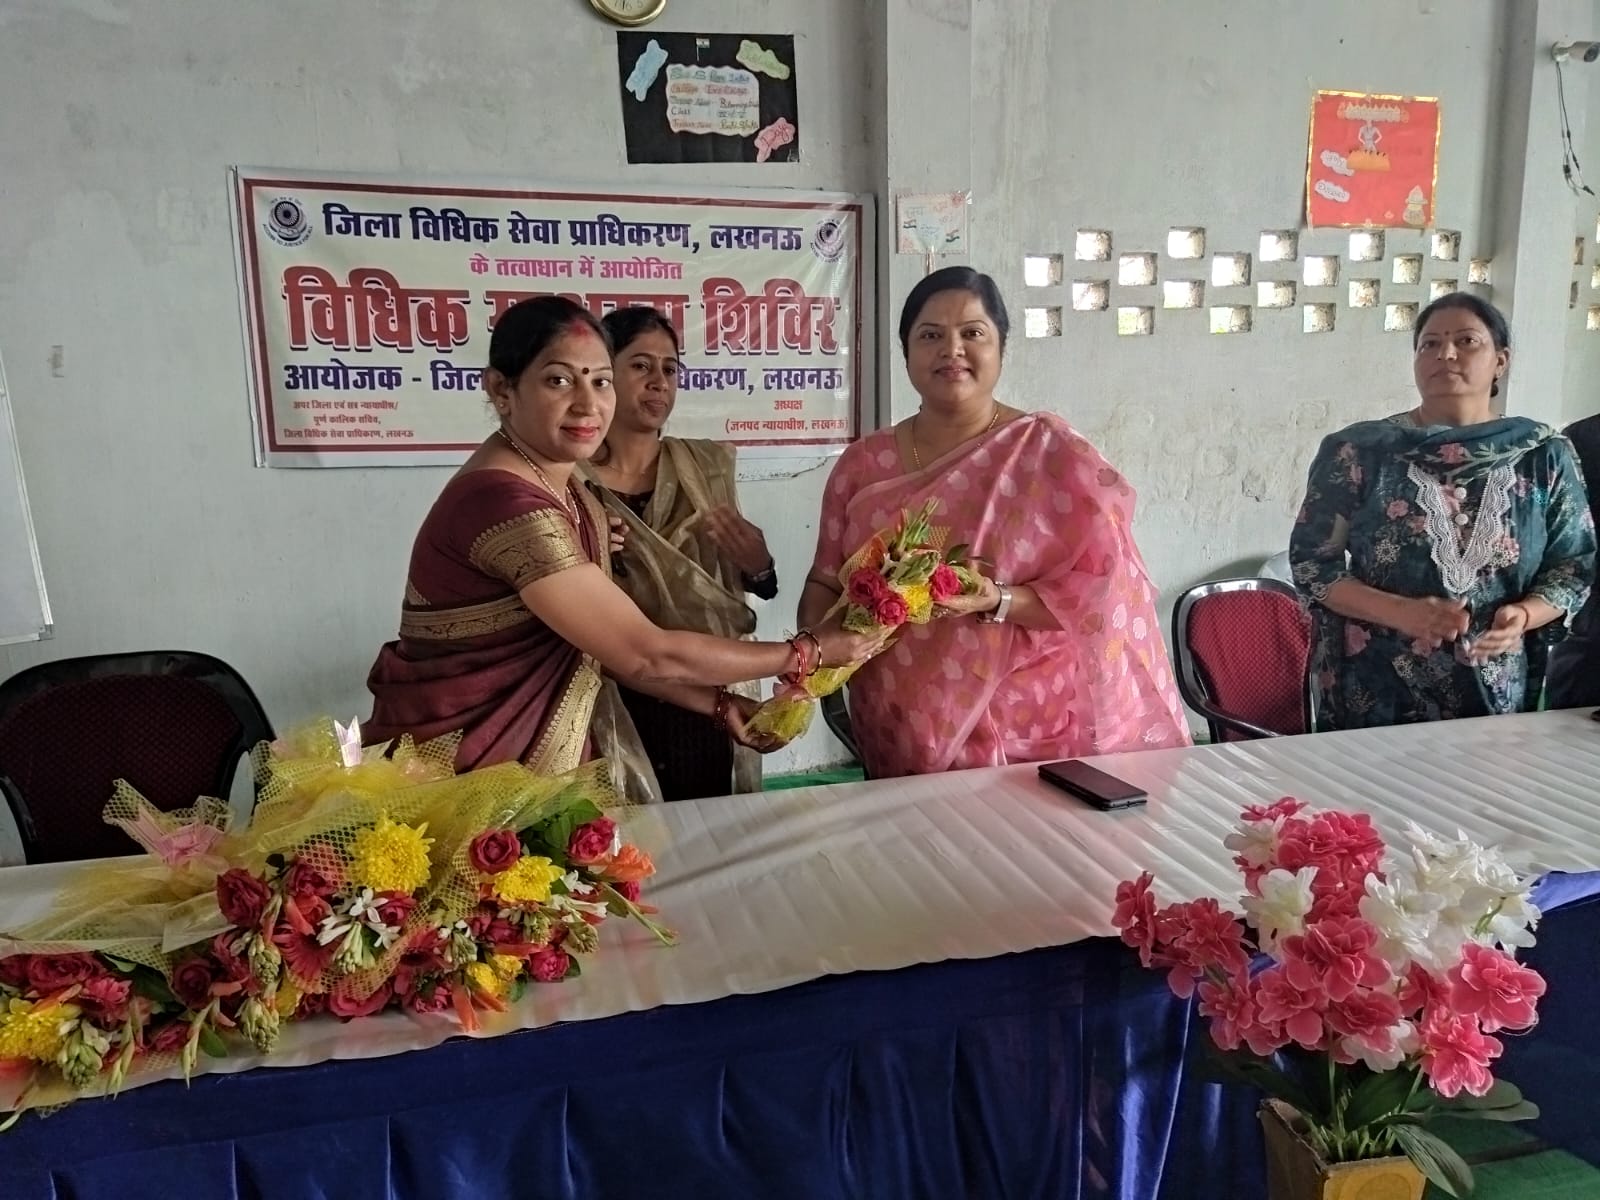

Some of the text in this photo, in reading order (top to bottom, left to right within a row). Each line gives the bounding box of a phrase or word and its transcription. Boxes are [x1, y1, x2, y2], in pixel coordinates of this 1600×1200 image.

[322, 203, 803, 253] जिला विधिक सेवा प्राधिकरण, लखनऊ
[469, 253, 489, 275] के
[579, 256, 595, 278] में
[600, 256, 683, 280] आयोजित
[281, 266, 471, 353] विधिक
[701, 278, 842, 356] शिविर
[284, 358, 402, 391] आयोजक
[430, 360, 486, 391] जिल
[762, 367, 844, 391] लखनऊ
[773, 400, 803, 410] अध्यक्ष
[725, 418, 760, 433] (जनपद
[762, 417, 808, 432] न्यायाधीश,
